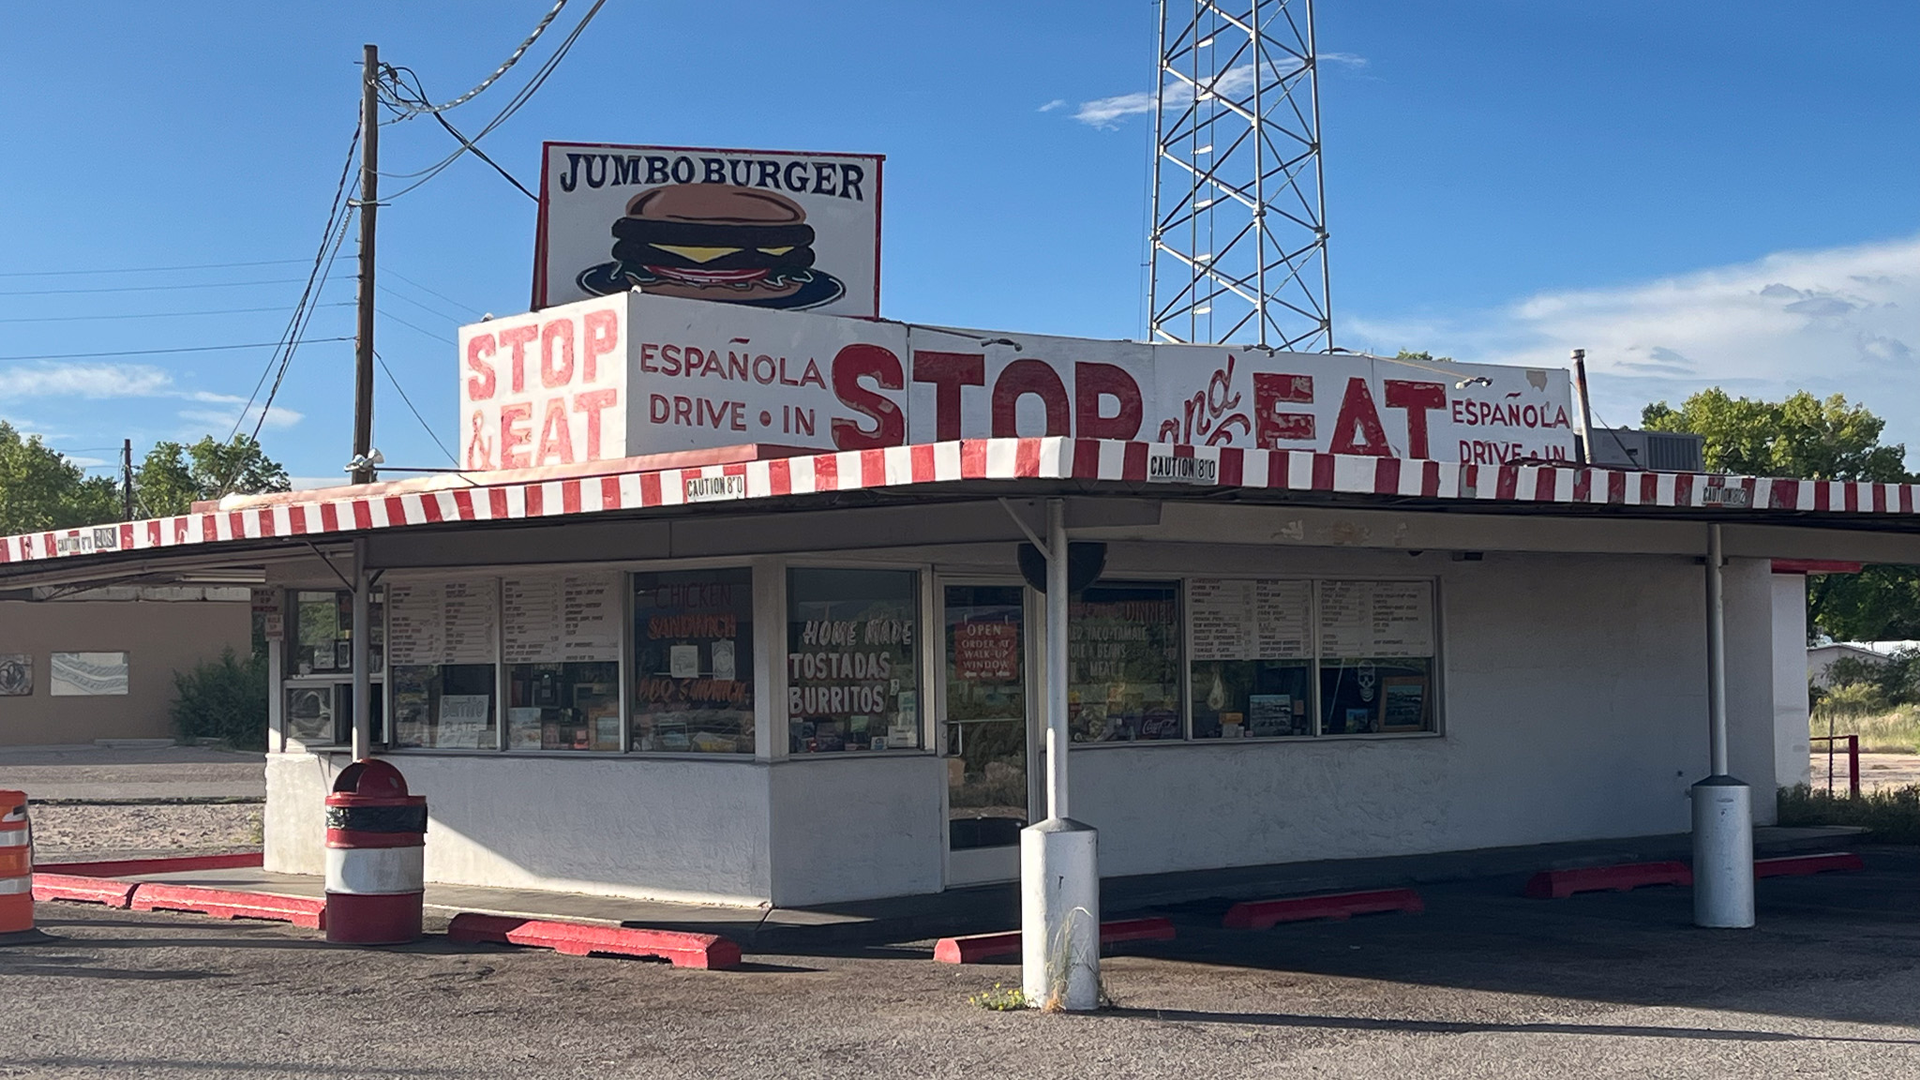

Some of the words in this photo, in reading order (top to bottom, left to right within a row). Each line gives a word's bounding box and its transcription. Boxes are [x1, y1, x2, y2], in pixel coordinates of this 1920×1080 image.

[468, 309, 618, 401] STOP
[641, 338, 827, 390] ESPAÑOLA
[831, 343, 1144, 450] STOP
[1253, 372, 1447, 459] EAT
[1452, 391, 1570, 429] ESPAÑOLA
[468, 410, 497, 471] &
[501, 388, 617, 470] EAT
[1150, 456, 1195, 478] CAUTION
[687, 476, 726, 498] CAUTION
[655, 582, 732, 610] CHICKEN
[647, 614, 736, 640] SANDWICH
[803, 620, 858, 646] HOME
[865, 619, 912, 646] MADE
[967, 624, 1001, 636] OPEN
[961, 639, 994, 648] ORDER
[789, 651, 891, 680] TOSTADAS
[963, 660, 1008, 669] WINDOW
[638, 678, 674, 702] BBQ
[789, 685, 884, 714] BURRITOS
